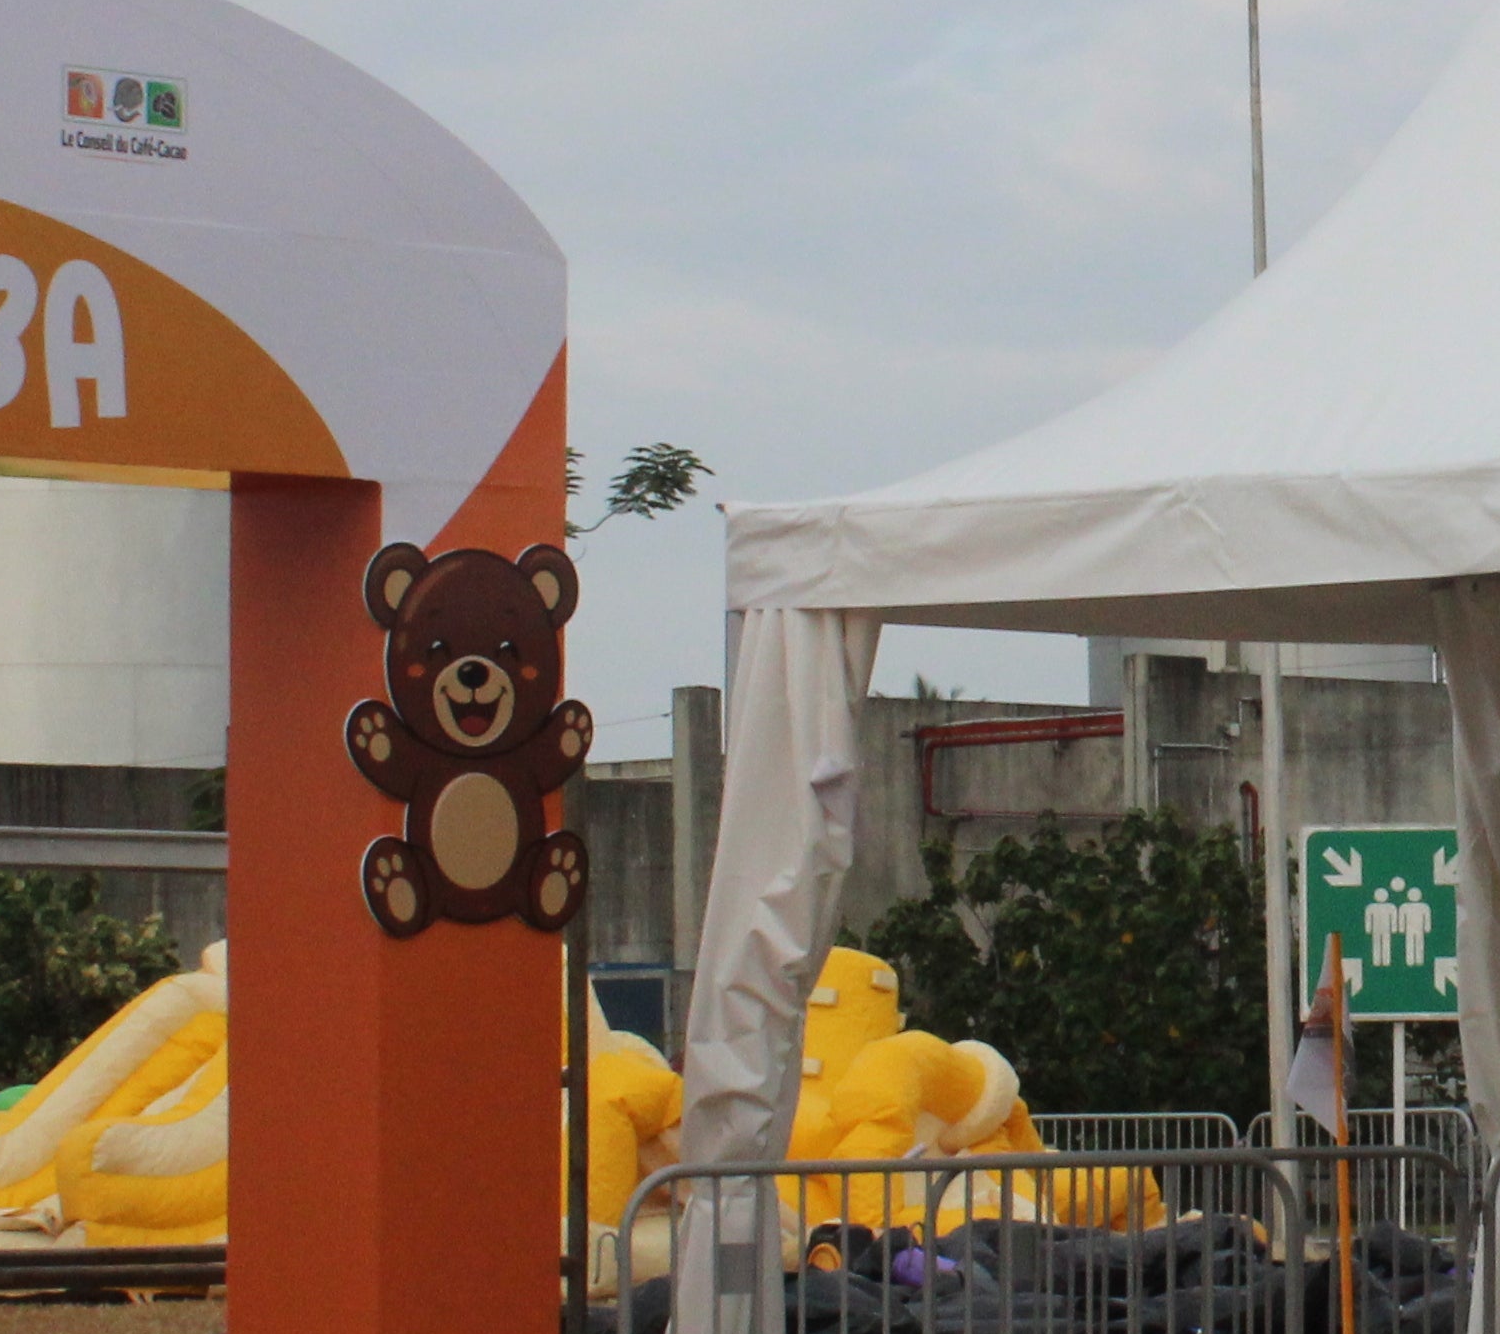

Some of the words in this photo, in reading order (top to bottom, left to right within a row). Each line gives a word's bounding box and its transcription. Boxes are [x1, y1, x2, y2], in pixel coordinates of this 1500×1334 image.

[61, 129, 74, 147] Le
[77, 131, 114, 151] Conseil
[116, 135, 128, 153] du
